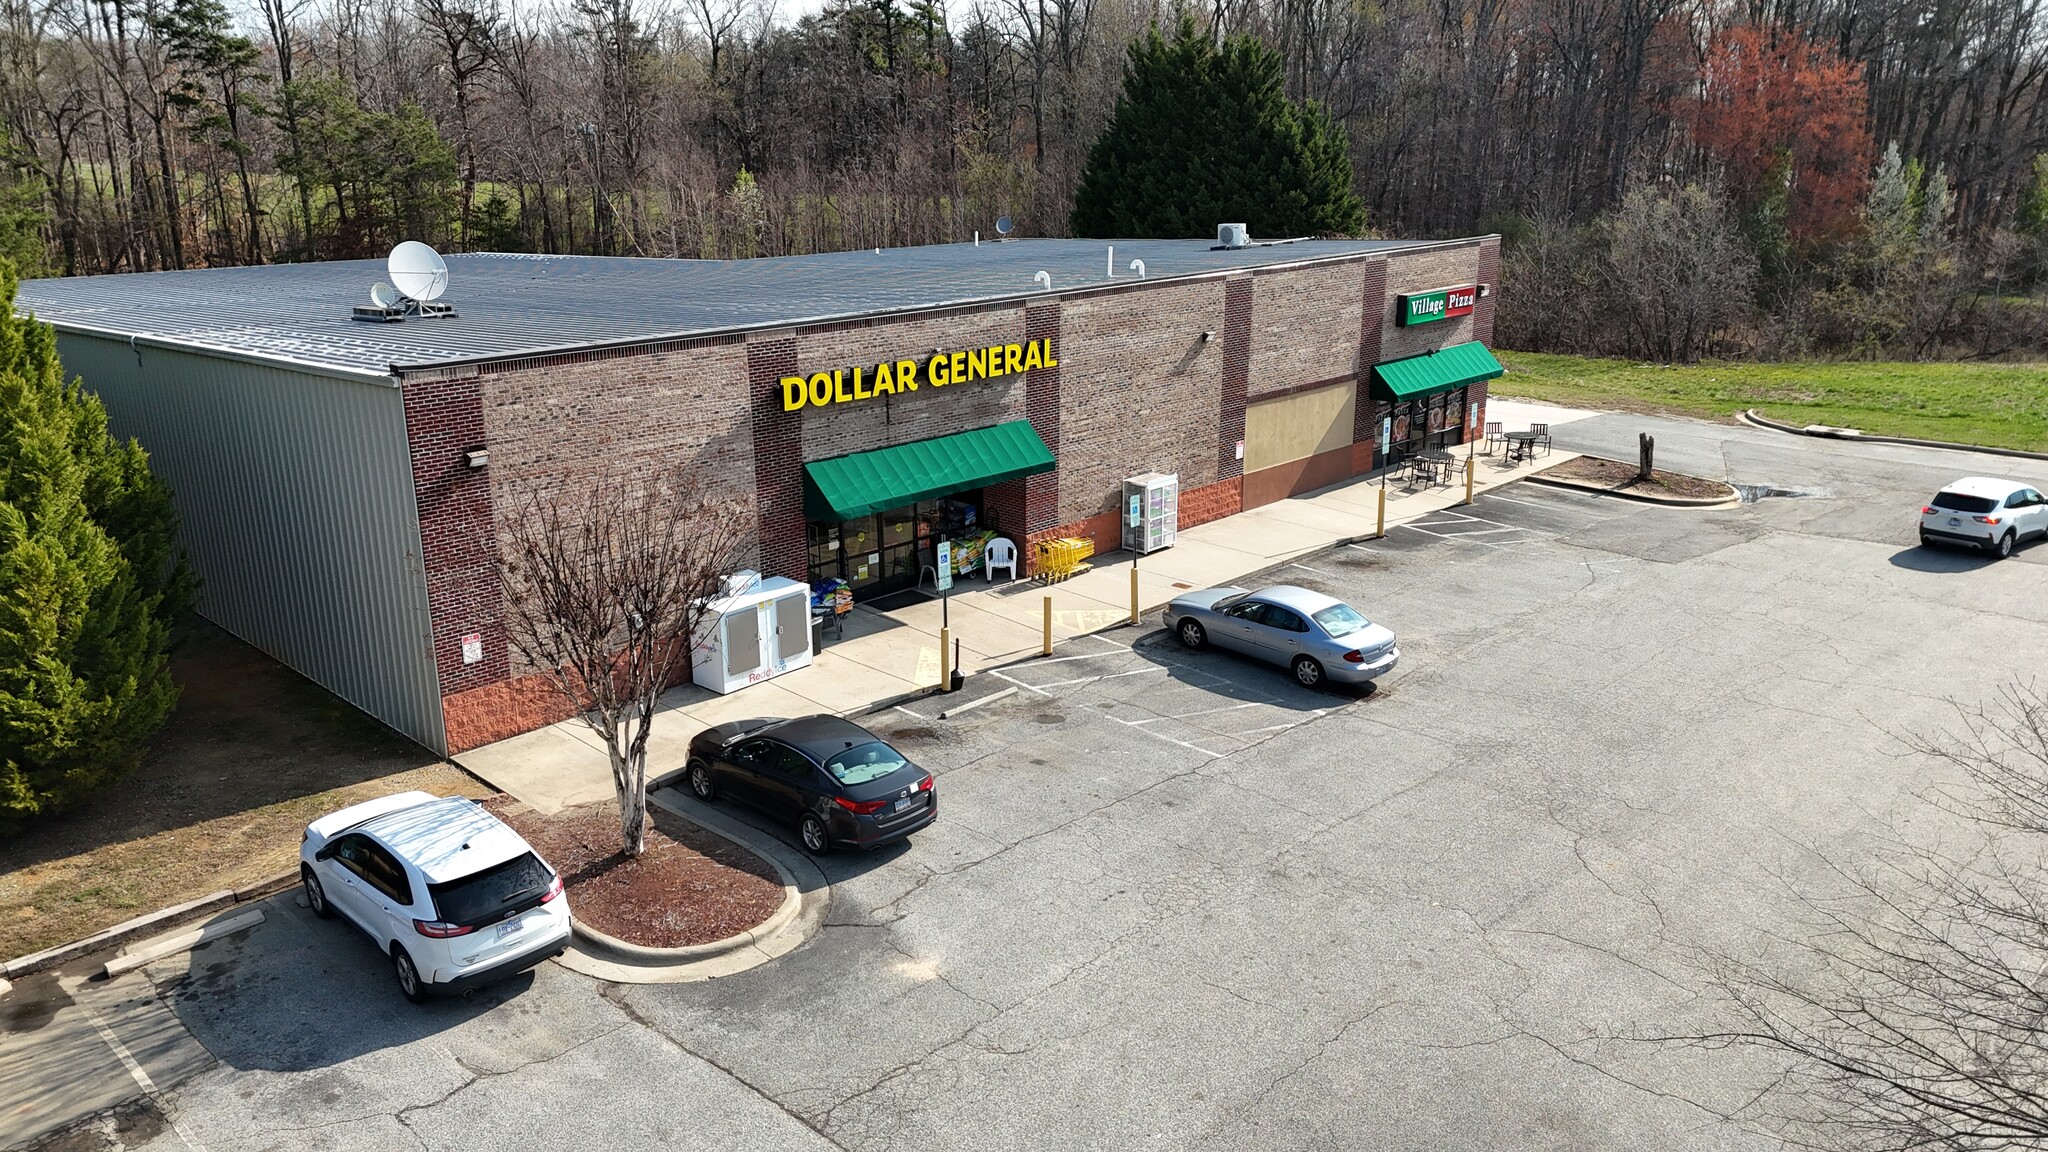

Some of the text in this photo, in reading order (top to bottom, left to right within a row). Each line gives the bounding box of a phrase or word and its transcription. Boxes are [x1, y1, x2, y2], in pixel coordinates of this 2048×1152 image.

[1411, 293, 1474, 315] Village Pizza
[780, 338, 1058, 412] DOLLAR GENERAL
